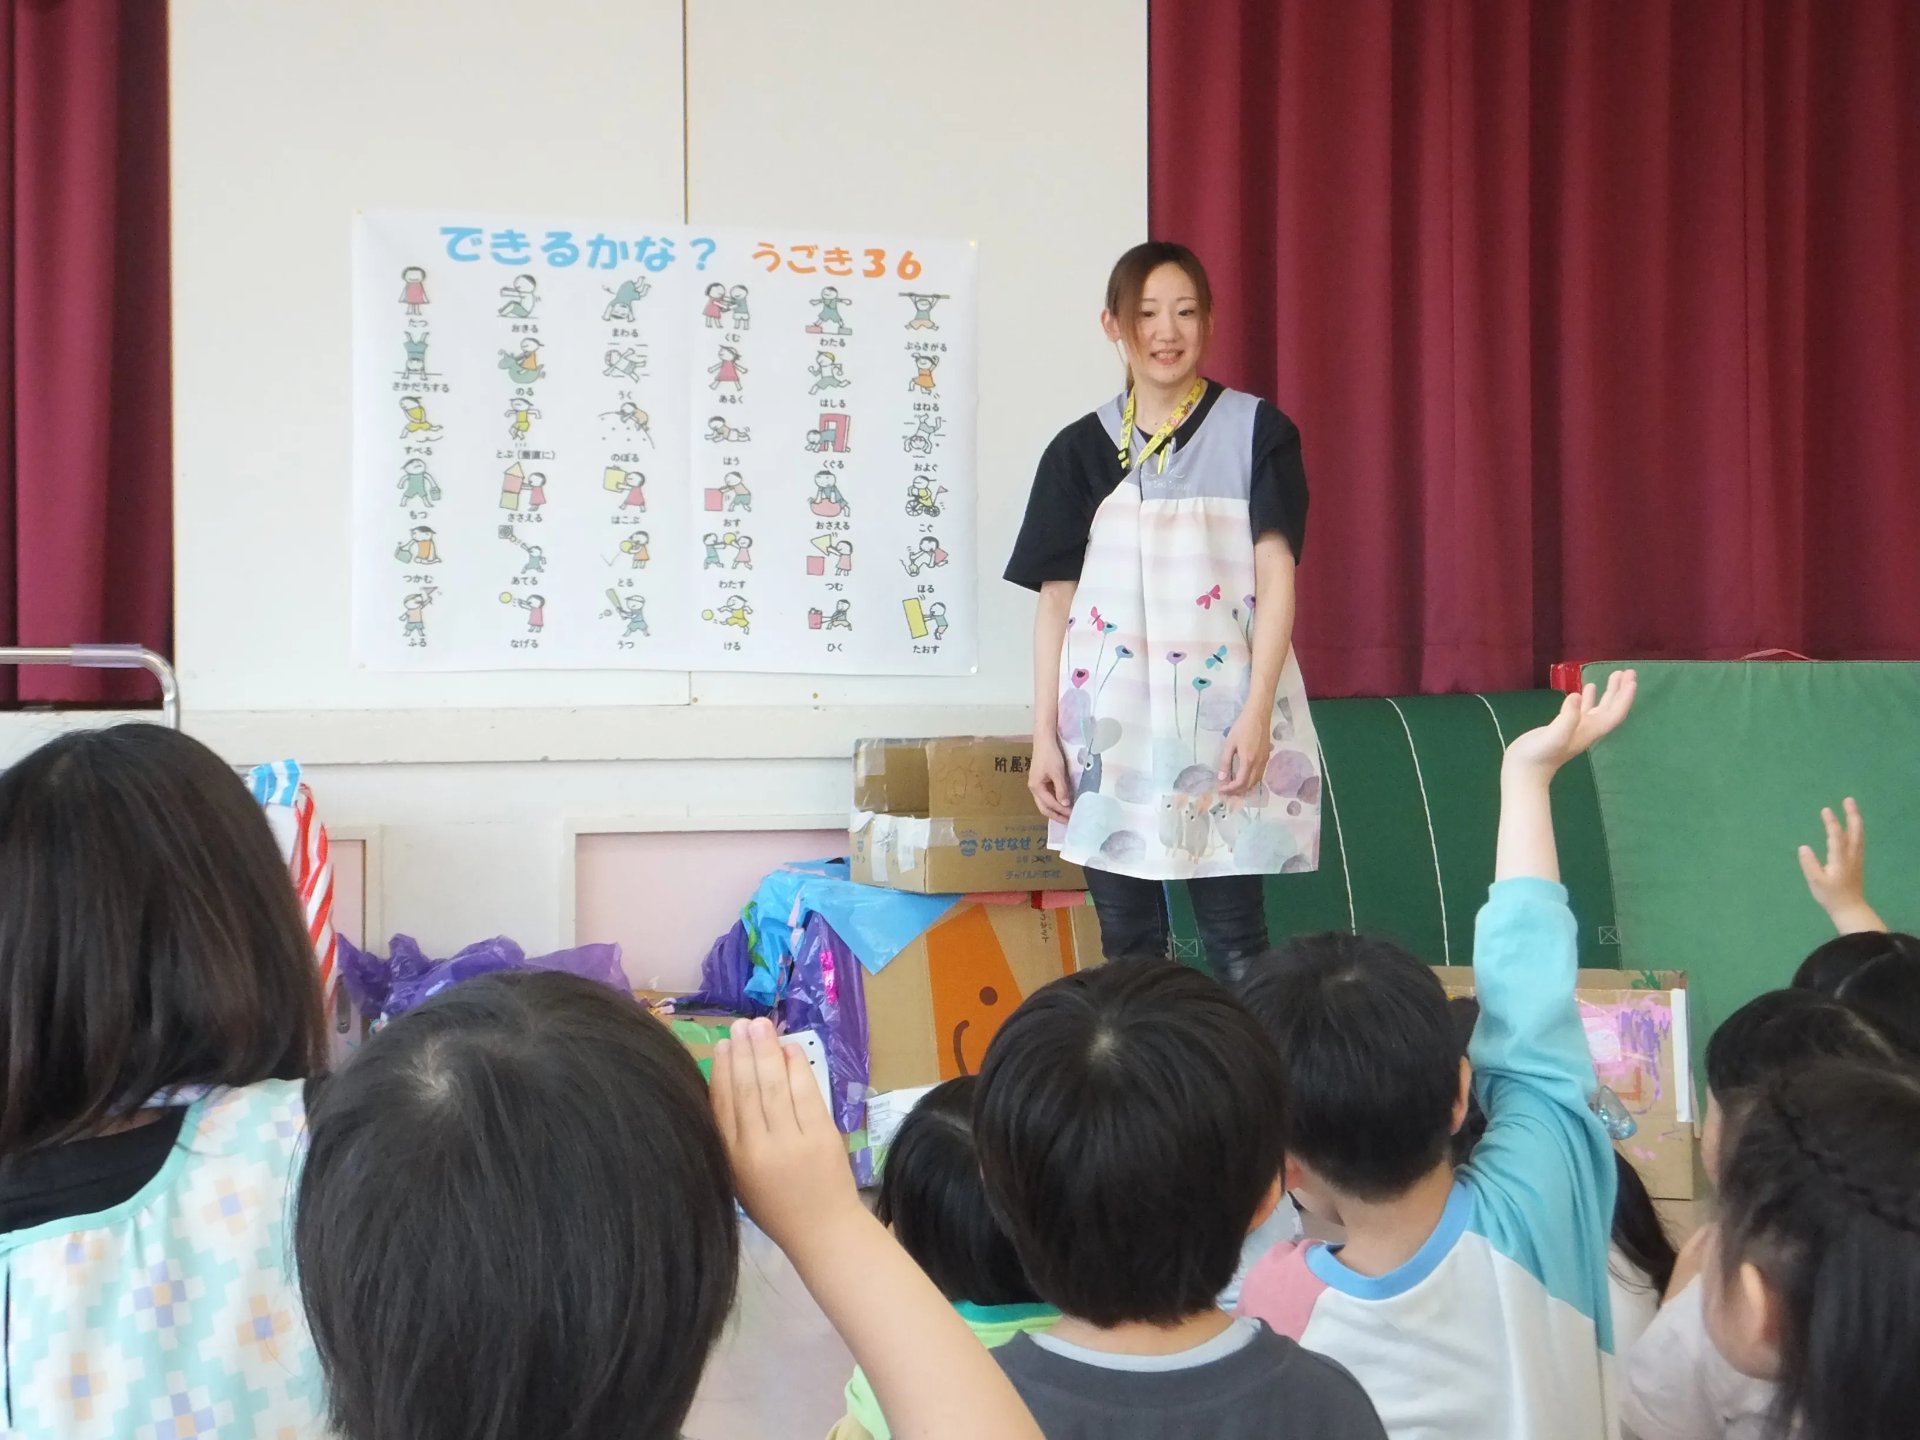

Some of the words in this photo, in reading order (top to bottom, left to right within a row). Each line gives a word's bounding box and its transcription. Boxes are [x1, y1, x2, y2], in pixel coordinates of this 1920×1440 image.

[439, 226, 717, 273] できるかな？
[751, 241, 923, 281] うごき36
[511, 323, 539, 334] おきる
[611, 327, 639, 339] まわる
[724, 332, 741, 343] くむ
[819, 337, 847, 348] わたる
[392, 381, 450, 394] さかだちする
[515, 386, 535, 397] のる
[718, 394, 744, 405] あるく
[819, 398, 847, 409] はしる
[912, 401, 940, 413] はねる
[404, 445, 433, 457] すべる
[722, 456, 740, 466] はう
[822, 459, 845, 470] くぐる
[913, 462, 939, 473] およぐ
[409, 509, 428, 521] もつ
[507, 512, 543, 524] ささえる
[723, 518, 742, 528] おす
[815, 520, 851, 531] おさえる
[402, 574, 434, 584] つかむ
[510, 575, 539, 586] あてる
[617, 578, 635, 588] とる
[718, 579, 747, 590] わたす
[824, 582, 844, 592] つむ
[407, 637, 428, 648] ふる
[510, 638, 539, 649] なげる
[617, 639, 635, 650] うつ
[723, 641, 742, 652] ける
[826, 642, 843, 653] ひく
[912, 644, 941, 655] たおす
